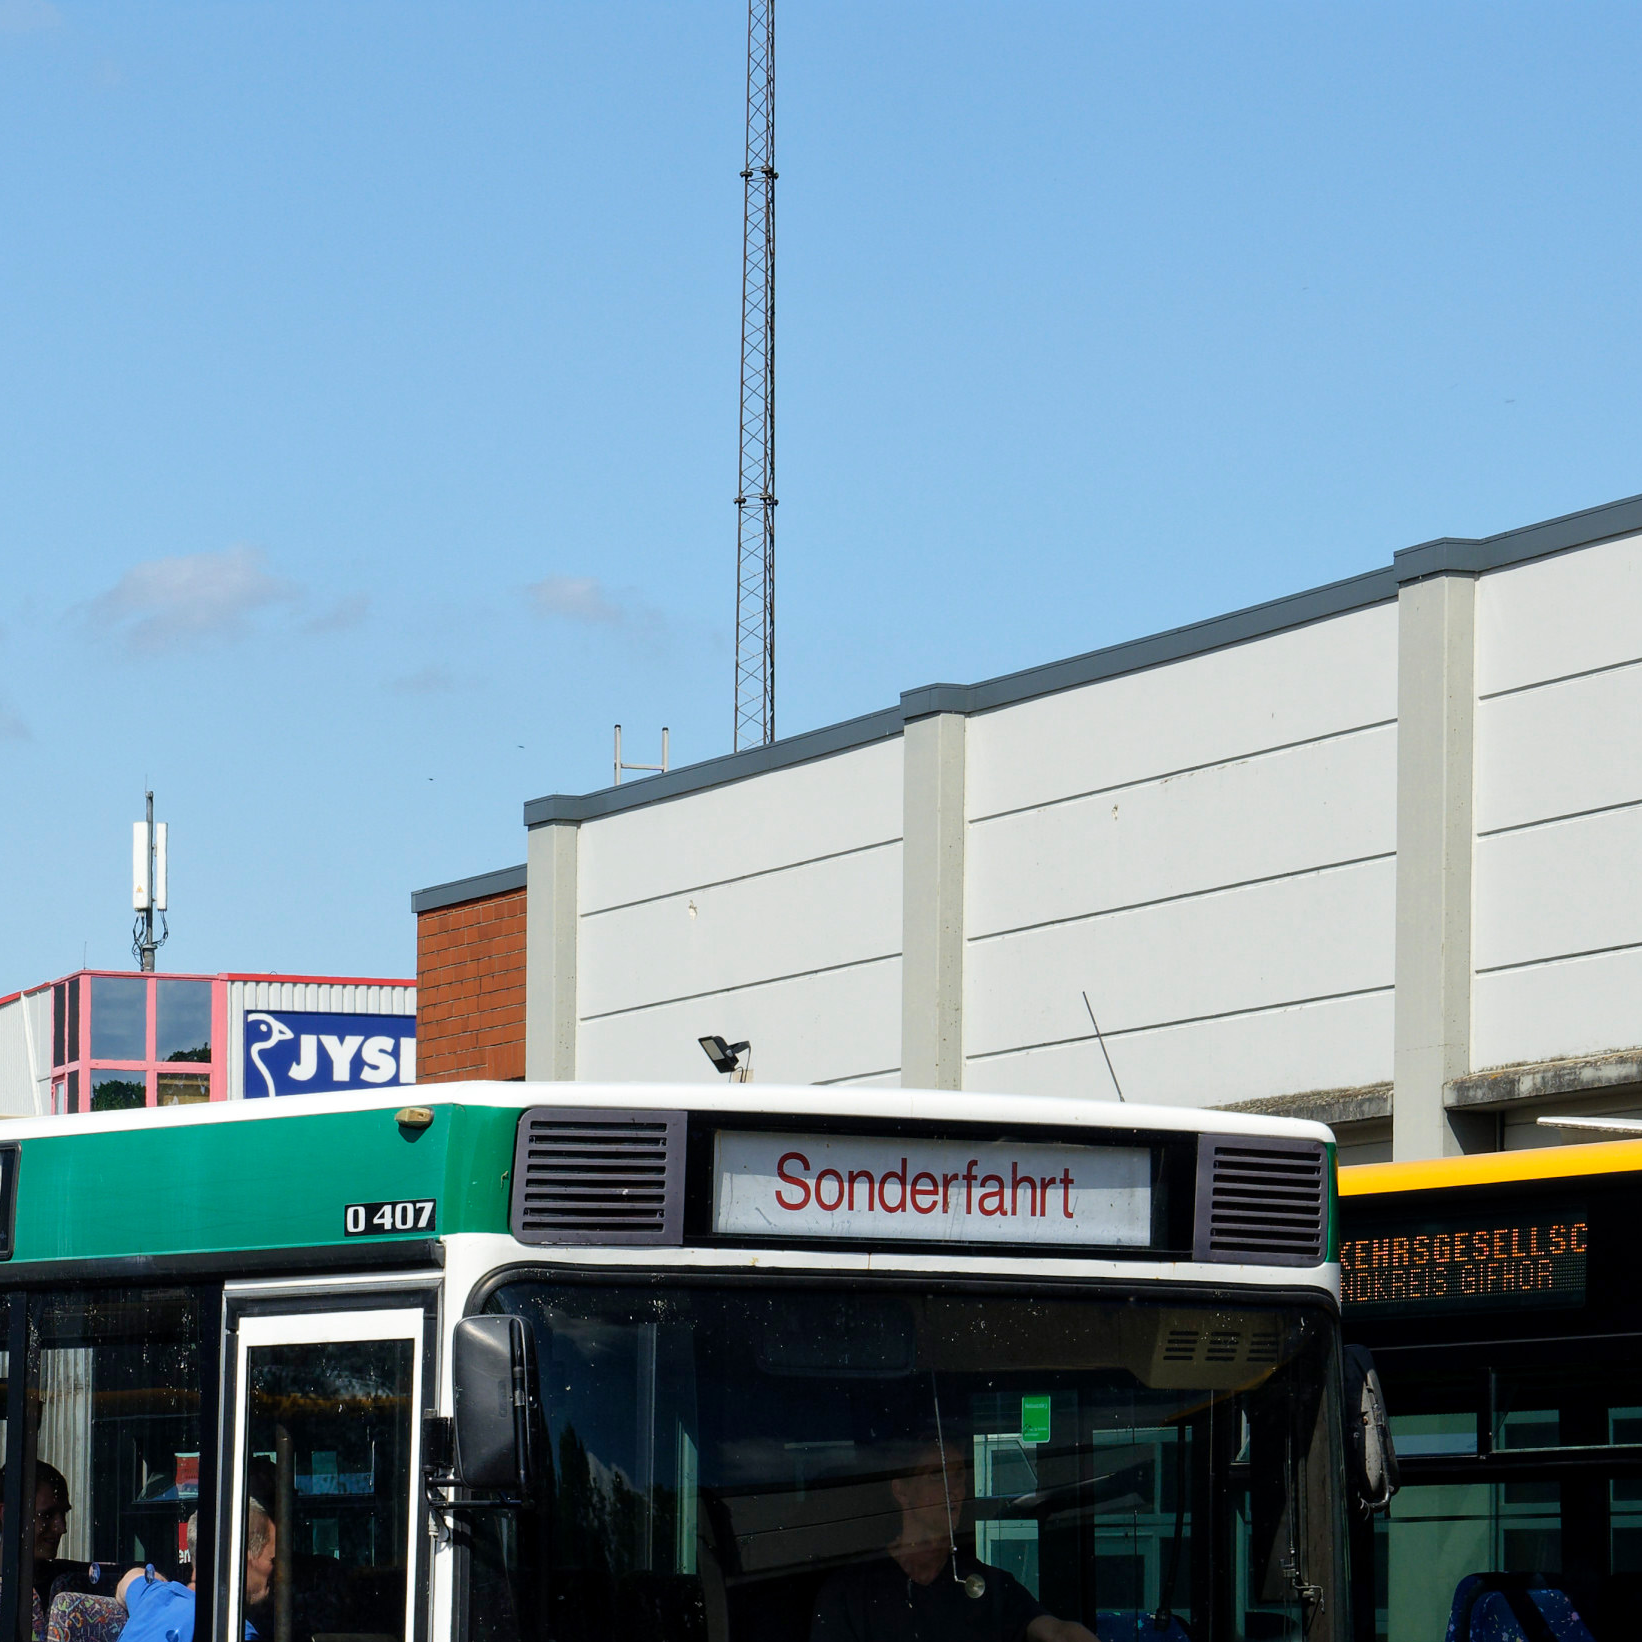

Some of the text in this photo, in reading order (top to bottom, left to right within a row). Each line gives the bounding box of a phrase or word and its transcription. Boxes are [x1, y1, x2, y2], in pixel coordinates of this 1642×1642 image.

[774, 1151, 1075, 1220] Sonderfahrt
[373, 1201, 435, 1231] 407
[1461, 1258, 1553, 1294] GIFHOR
